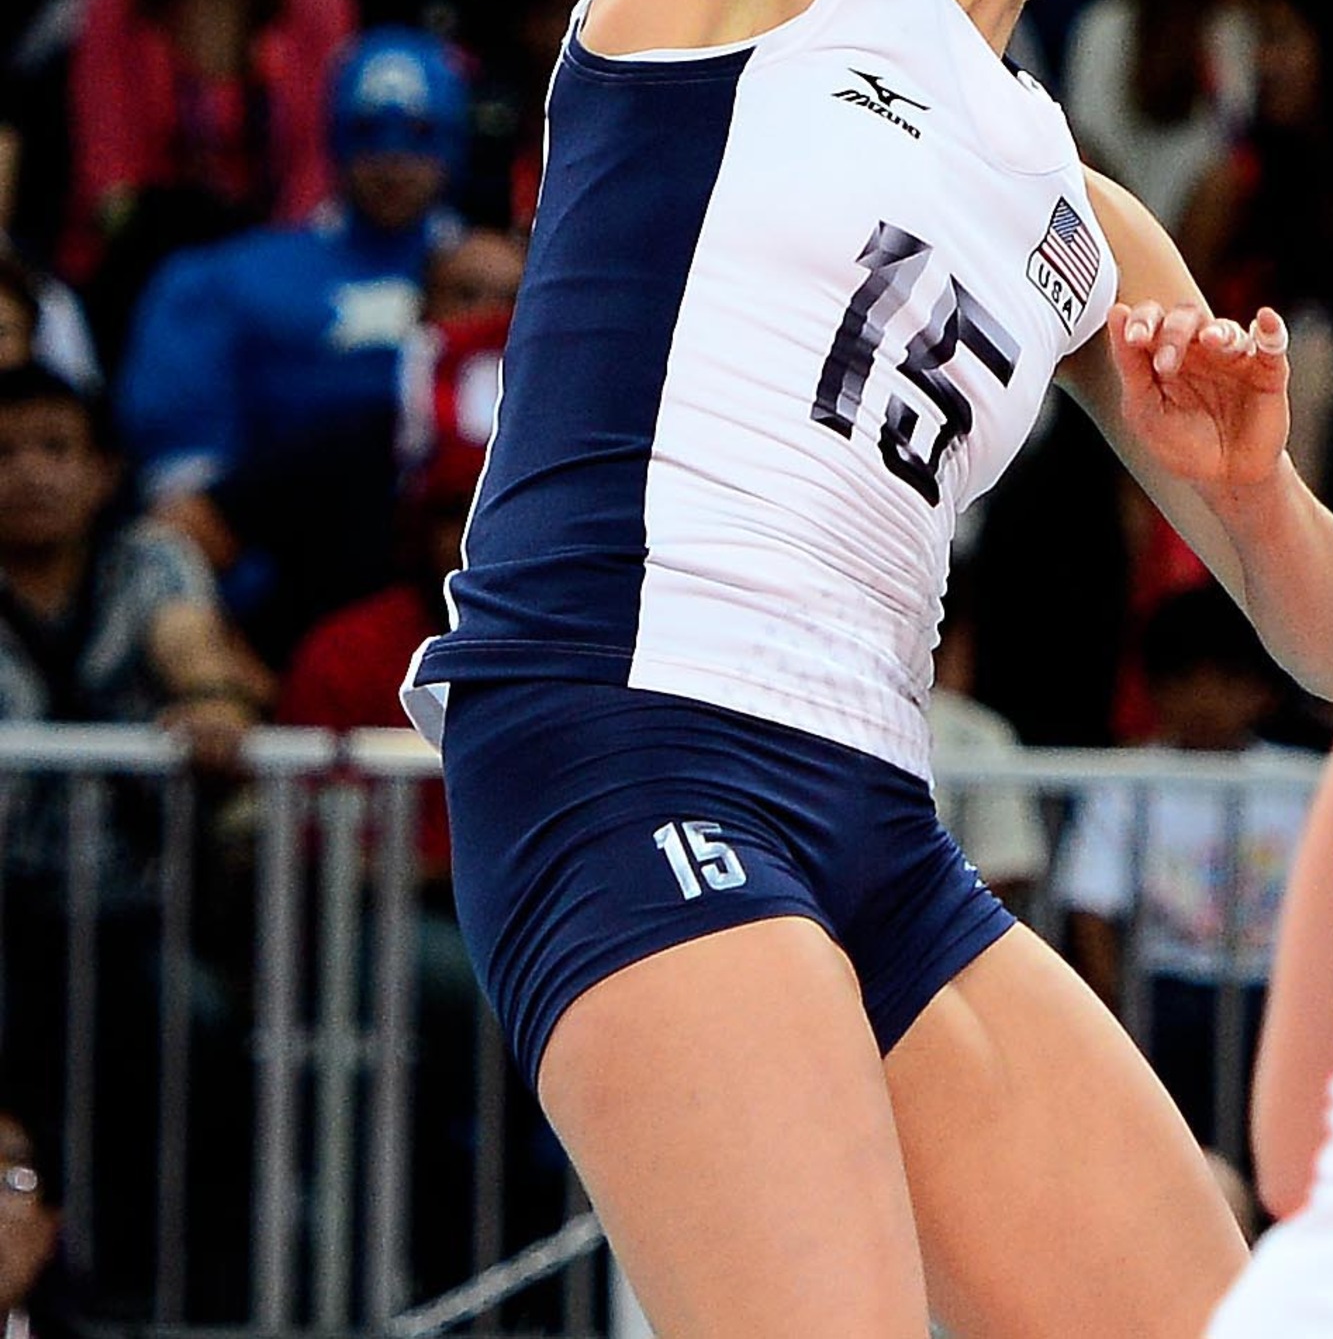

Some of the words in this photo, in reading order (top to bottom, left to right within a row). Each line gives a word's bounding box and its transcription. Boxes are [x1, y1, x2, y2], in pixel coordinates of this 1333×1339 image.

[1038, 263, 1073, 322] USA
[810, 220, 1022, 509] 15
[653, 821, 747, 901] 15
